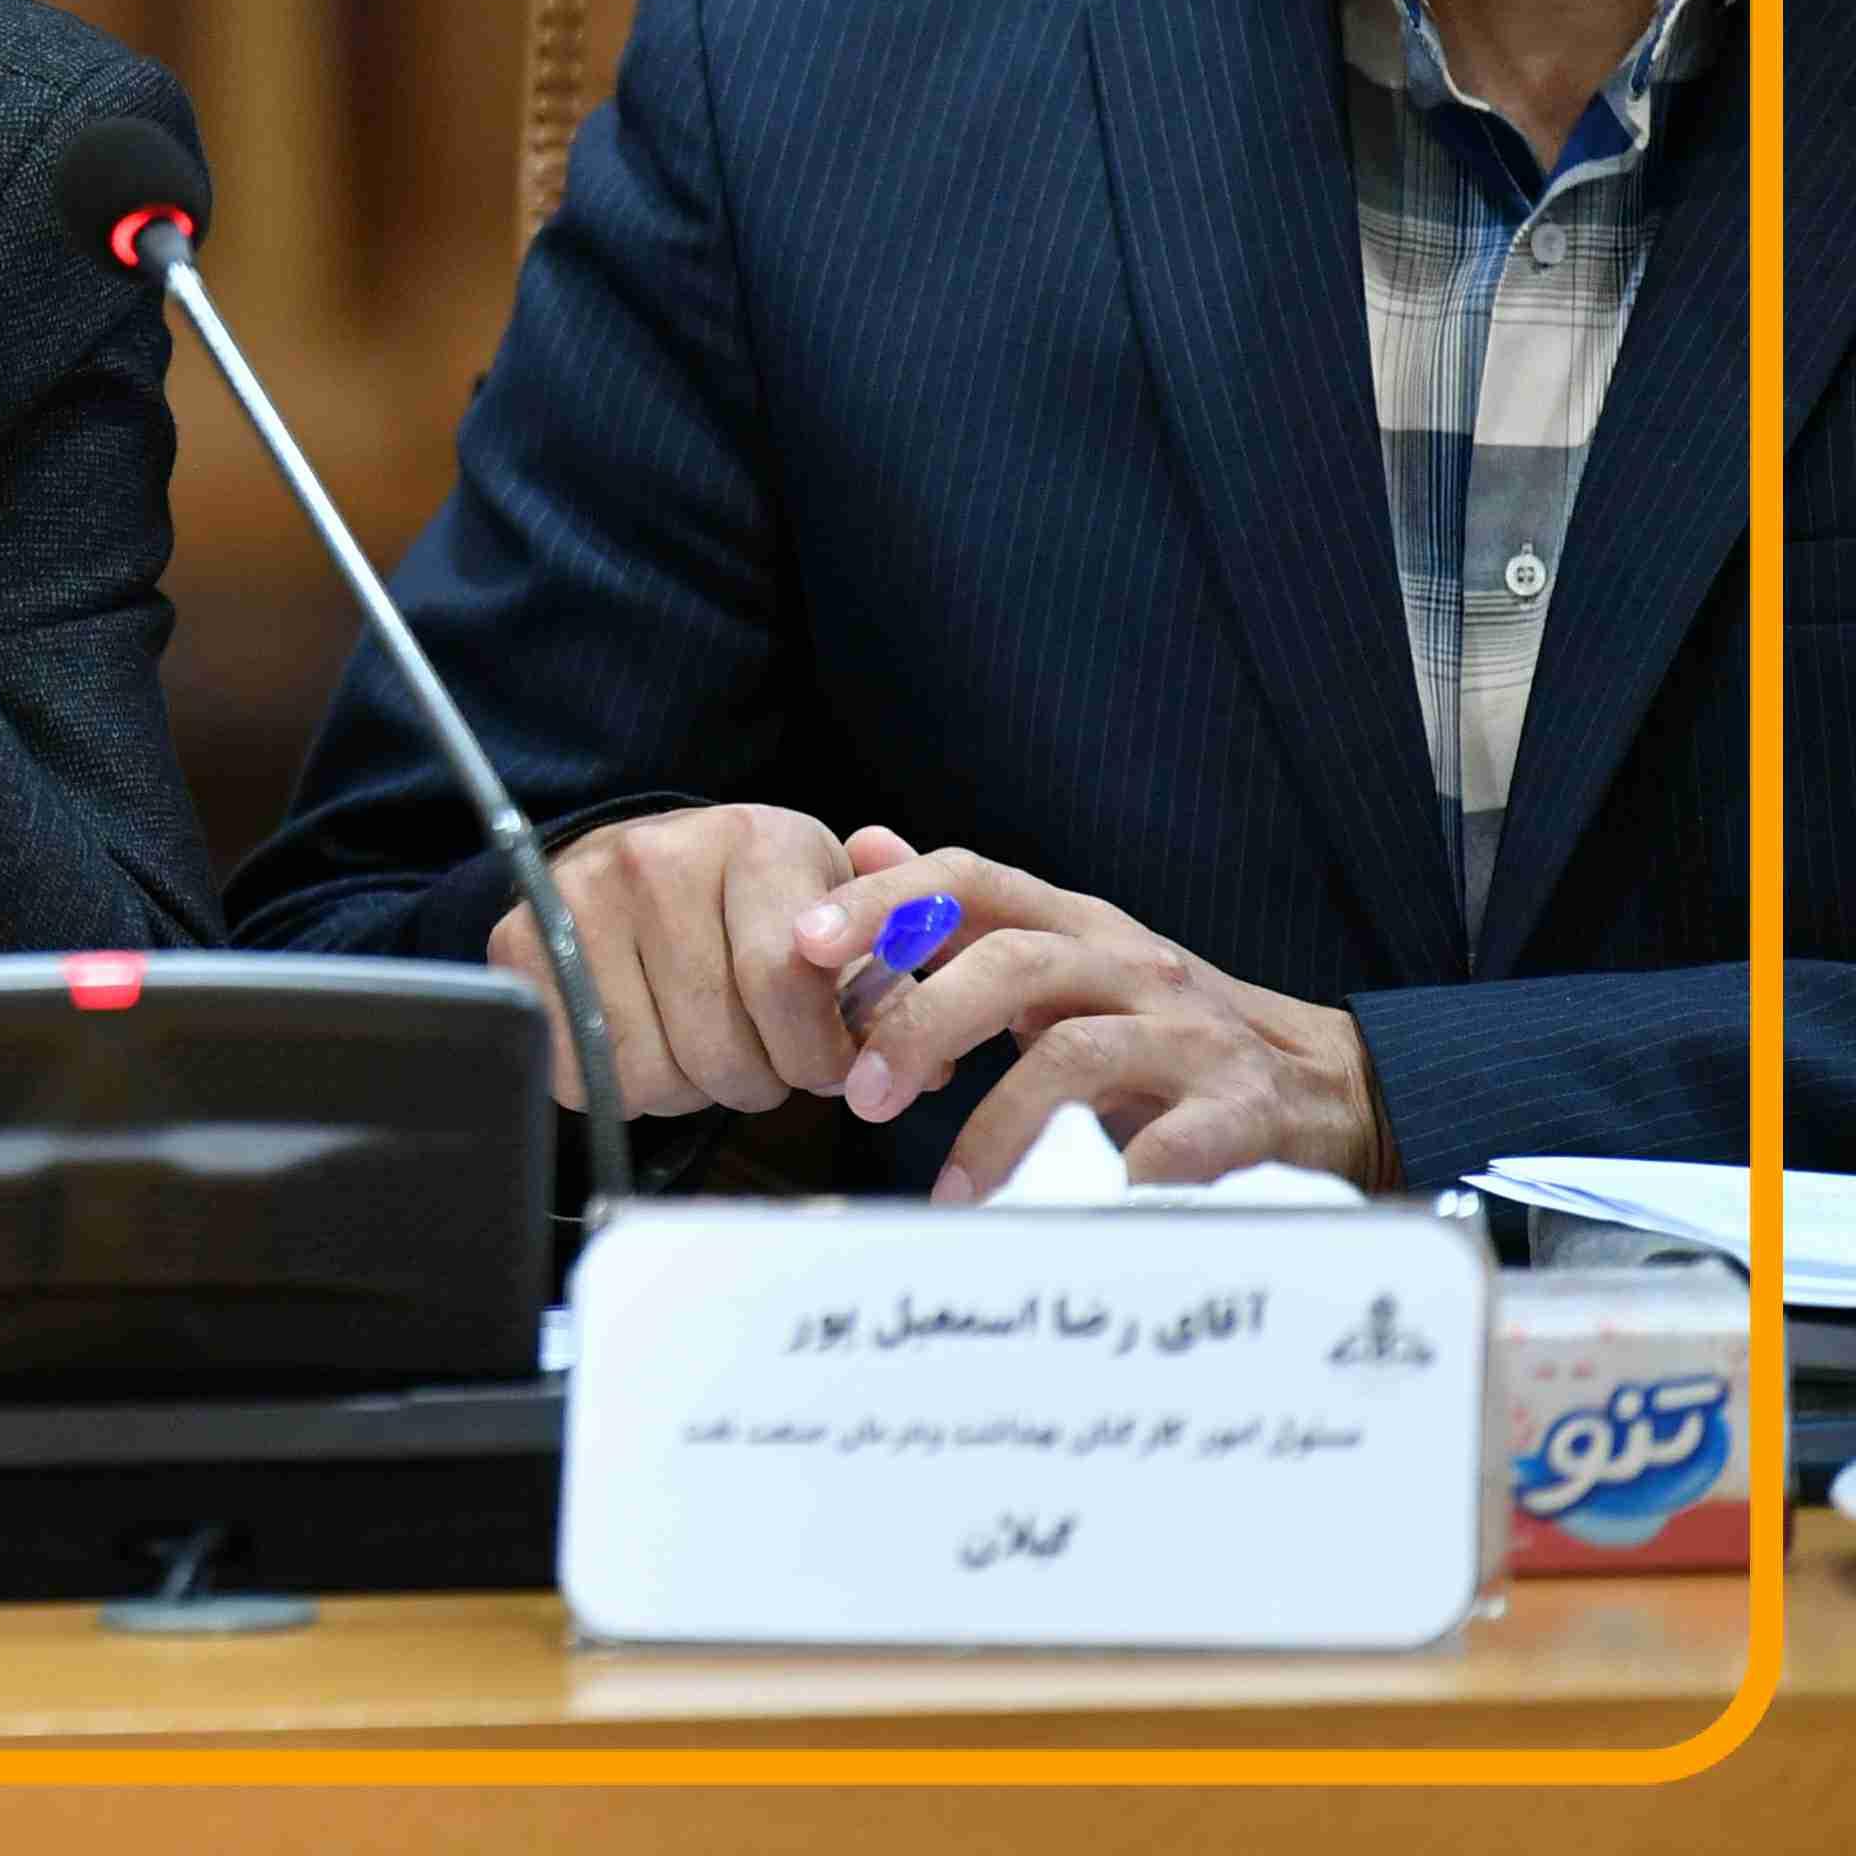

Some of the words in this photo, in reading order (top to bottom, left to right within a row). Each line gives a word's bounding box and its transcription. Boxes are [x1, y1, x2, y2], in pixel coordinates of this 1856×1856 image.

[1052, 1294, 1140, 1356] رضا
[1154, 1291, 1268, 1354] آقای
[1518, 1378, 1726, 1516] تنو
